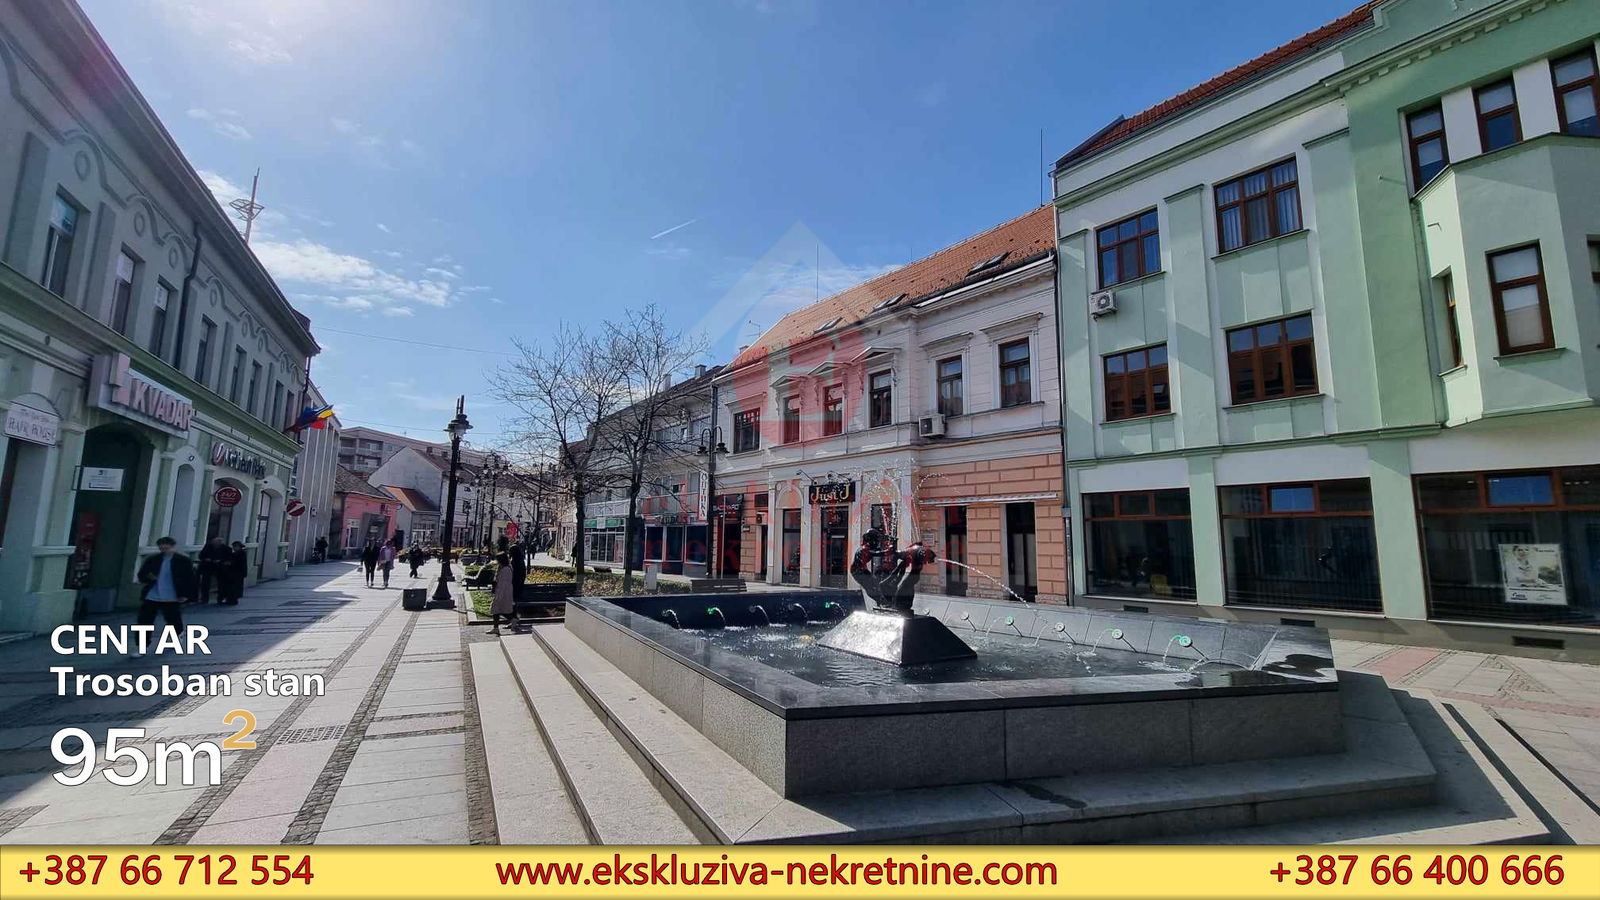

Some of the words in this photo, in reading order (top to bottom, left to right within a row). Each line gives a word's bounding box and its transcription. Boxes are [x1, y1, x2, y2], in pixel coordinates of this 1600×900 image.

[131, 378, 193, 430] KVADAR
[810, 486, 839, 502] Just
[840, 484, 851, 500] J
